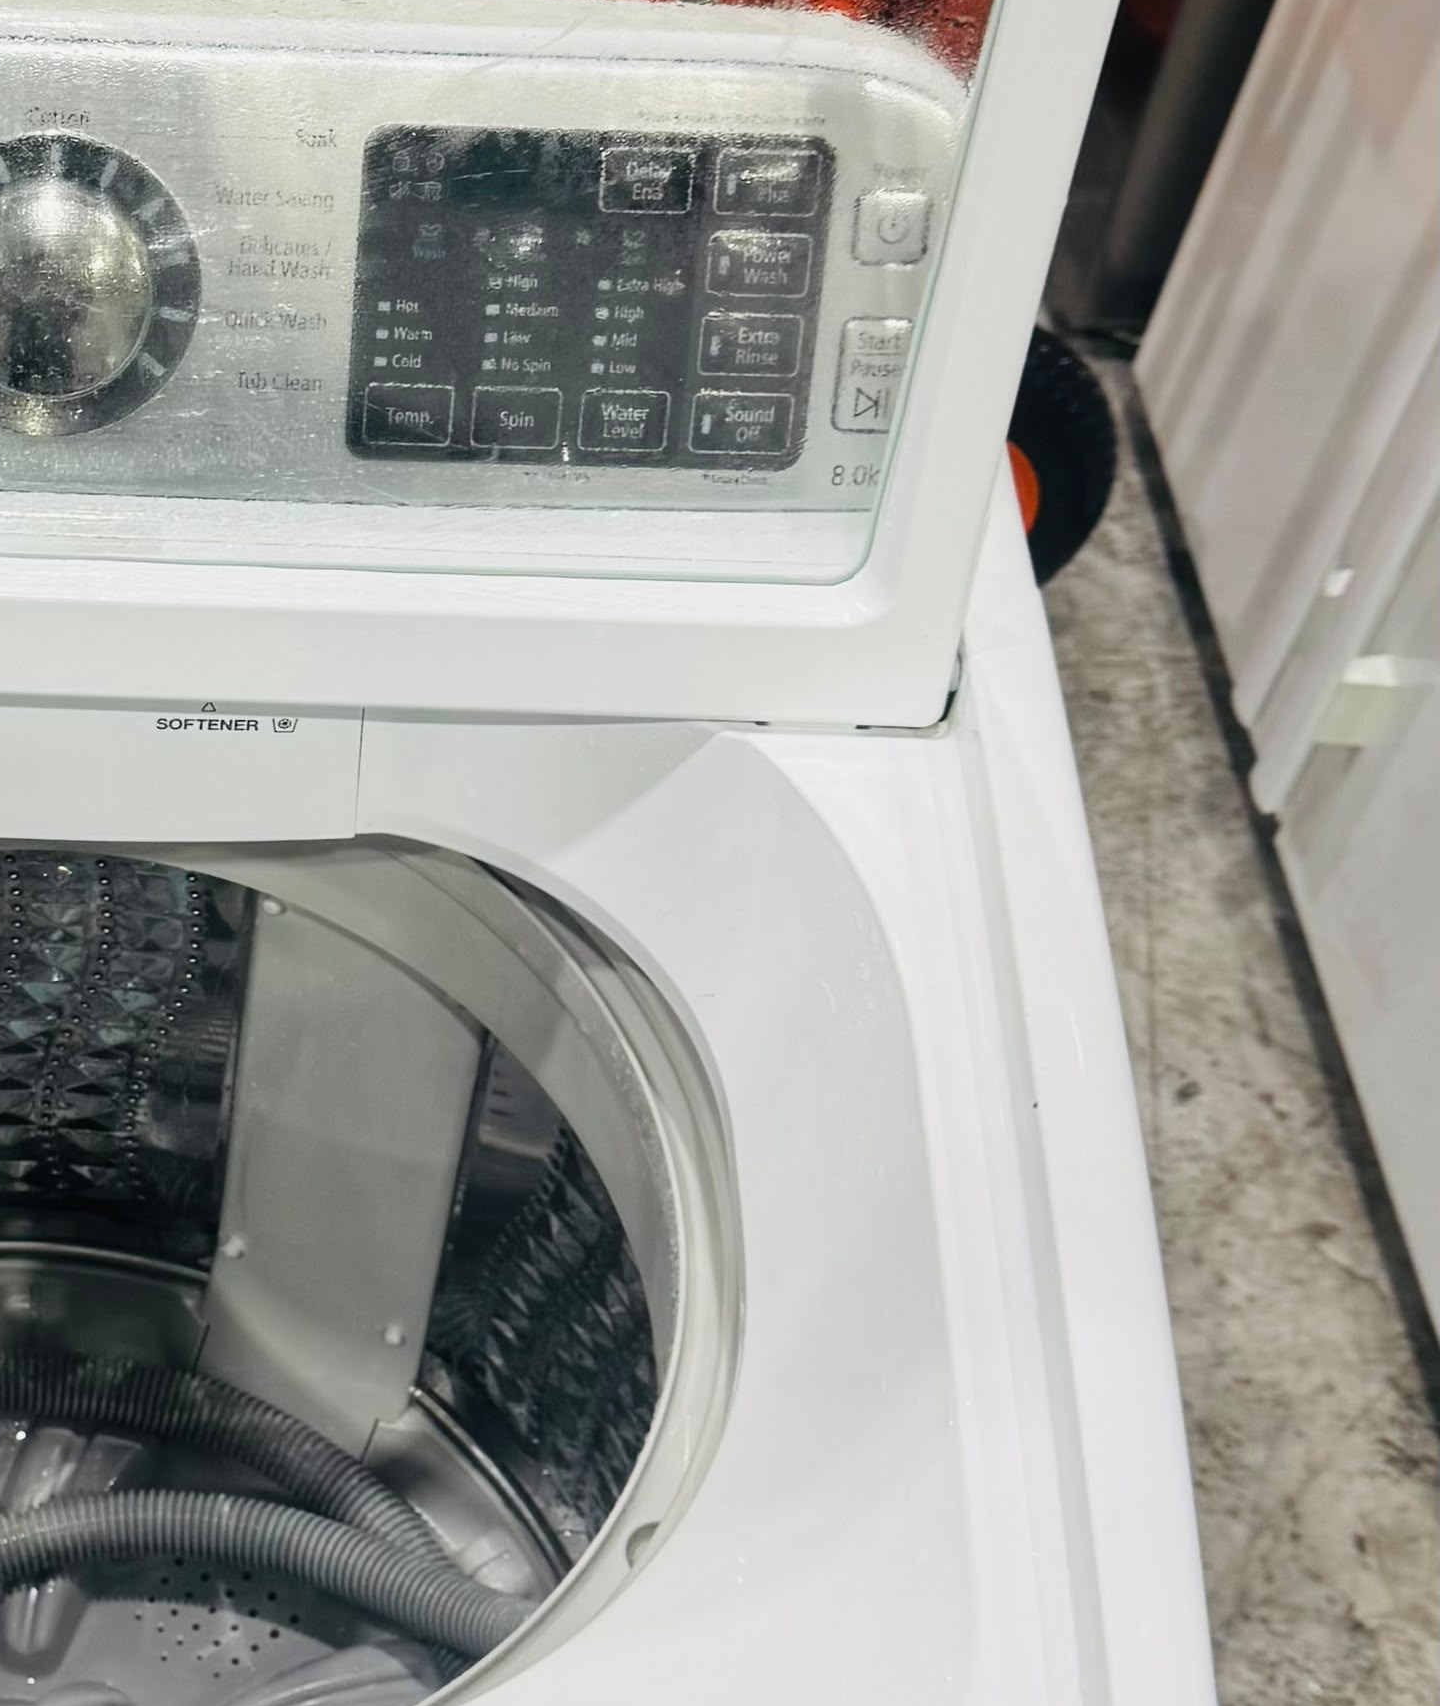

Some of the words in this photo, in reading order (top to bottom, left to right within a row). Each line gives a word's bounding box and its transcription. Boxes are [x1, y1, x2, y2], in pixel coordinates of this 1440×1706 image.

[742, 249, 792, 264] Power
[743, 268, 788, 286] Wash
[614, 305, 645, 322] High
[393, 327, 433, 342] Warm
[611, 332, 638, 348] Mid
[738, 328, 781, 345] Extra
[391, 354, 423, 369] Cold
[735, 349, 779, 366] Rinse
[522, 358, 552, 375] Spin
[609, 361, 637, 374] Low
[601, 403, 651, 420] Water
[724, 405, 776, 424] Sound
[498, 411, 536, 431] Spin
[602, 420, 646, 438] Level
[156, 717, 259, 732] SOFTENER
